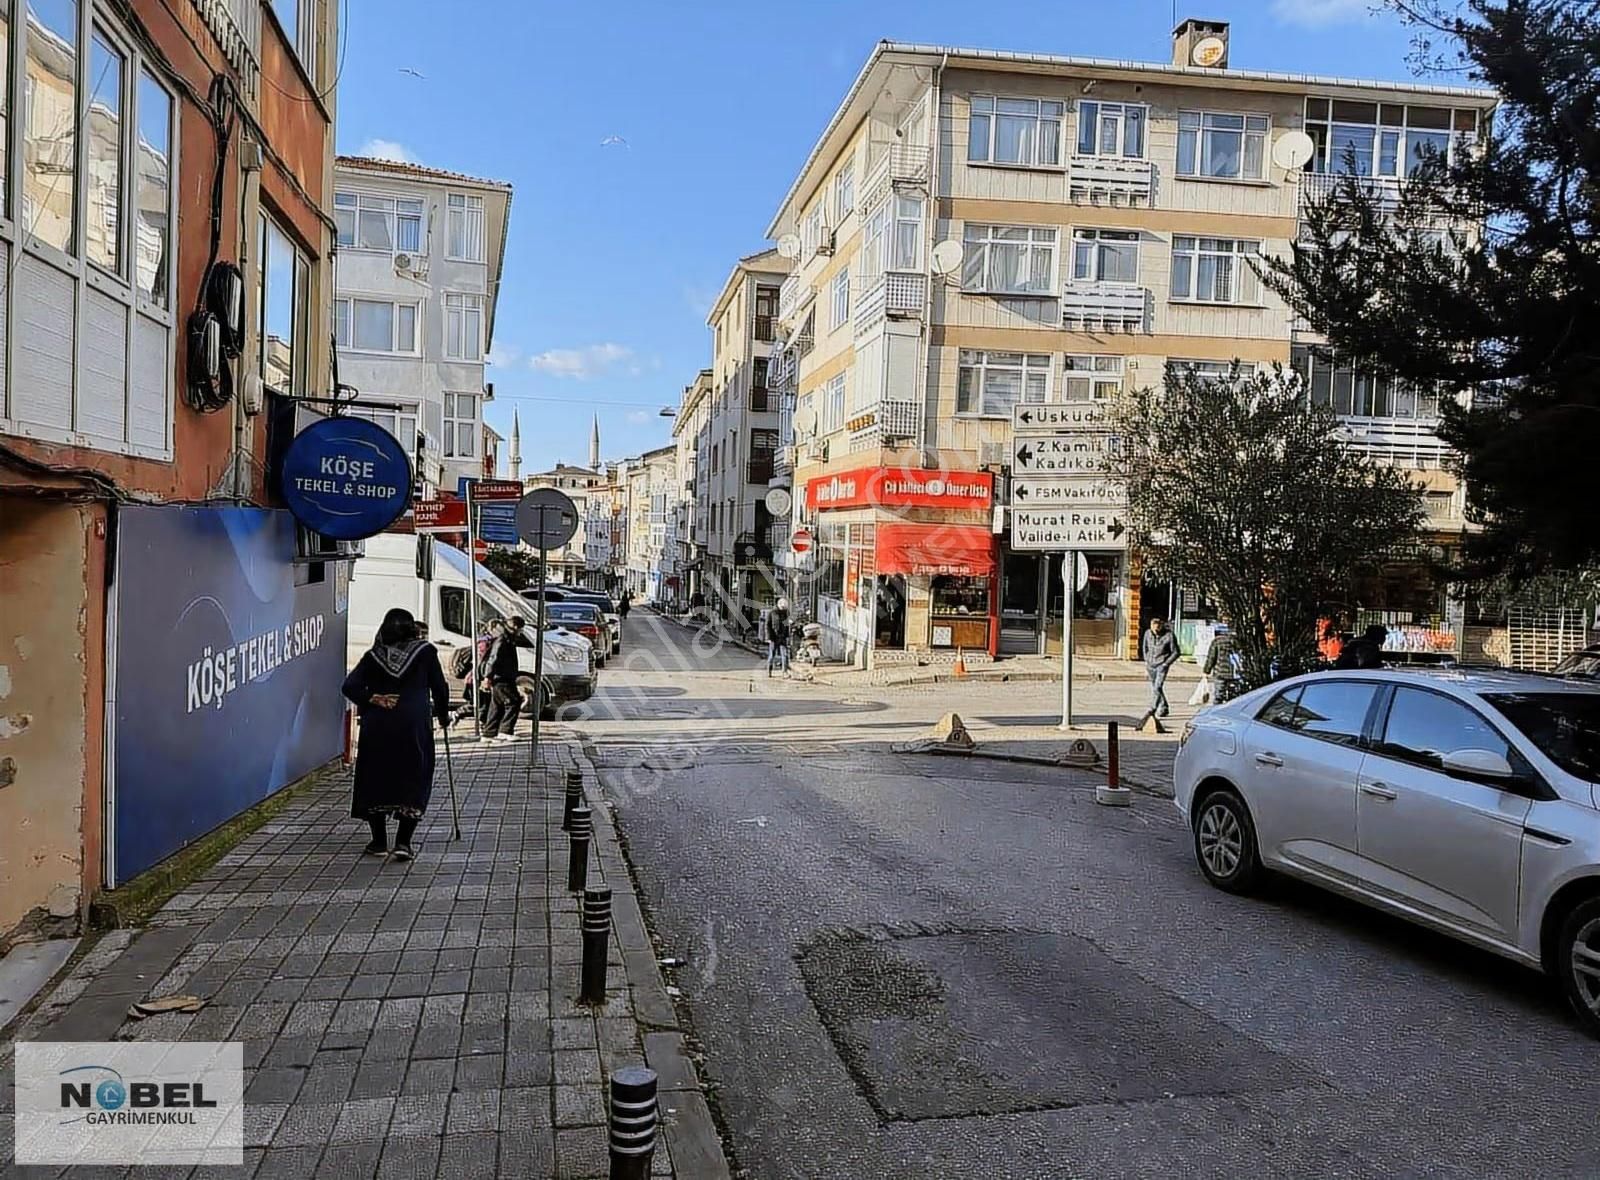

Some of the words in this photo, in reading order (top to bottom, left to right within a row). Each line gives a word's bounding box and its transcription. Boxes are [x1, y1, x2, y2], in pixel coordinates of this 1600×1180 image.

[320, 455, 374, 480] KÖŞE
[295, 477, 340, 494] TEKEL
[343, 484, 354, 495] &
[357, 483, 397, 499] SHOP
[969, 483, 988, 497] Usta
[1036, 488, 1061, 498] FSM
[1064, 488, 1095, 497] Vakıf
[1018, 513, 1065, 525] Murat
[1072, 513, 1106, 525] Reis
[1019, 530, 1070, 542] Valide-i
[1078, 529, 1106, 541] Atik
[186, 645, 237, 713] KÖŞE
[240, 627, 281, 684] TEKEL
[282, 627, 294, 664] &
[294, 613, 325, 655] SHOP
